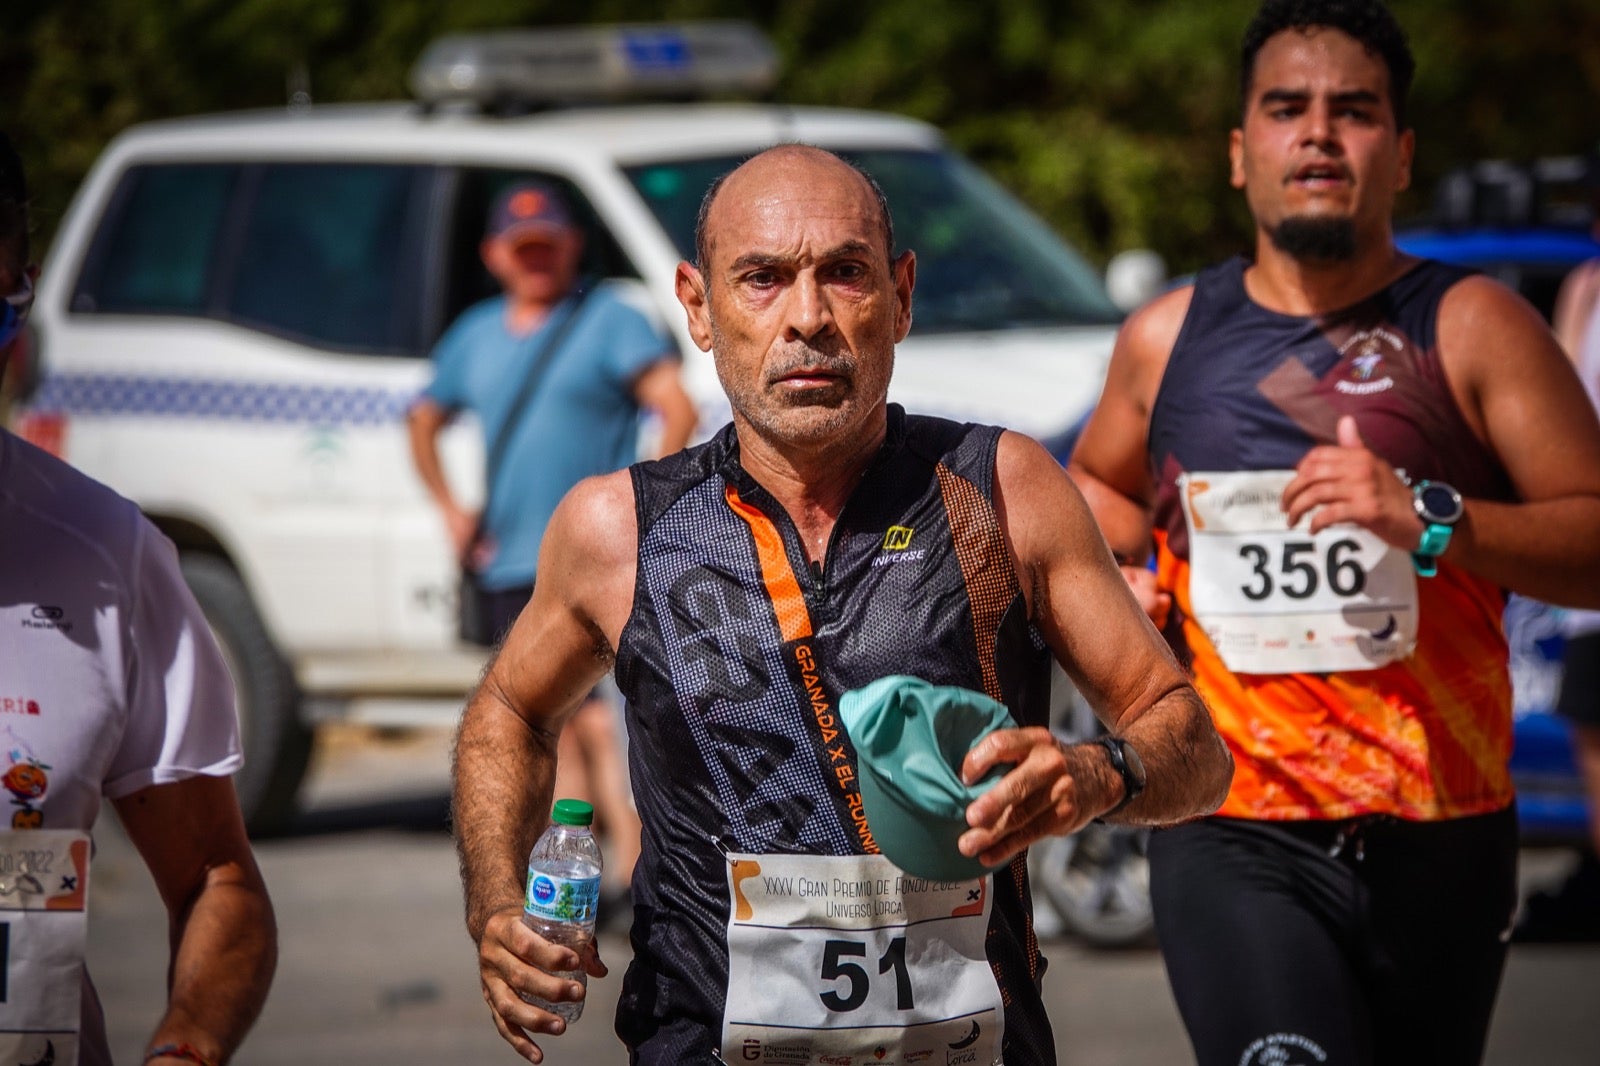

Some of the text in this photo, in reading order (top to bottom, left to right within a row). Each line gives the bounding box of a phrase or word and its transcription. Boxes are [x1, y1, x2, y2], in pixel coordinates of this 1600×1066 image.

[871, 549, 925, 567] INVERSE
[1239, 539, 1368, 601] 356
[795, 645, 839, 744] GRANADA
[828, 745, 847, 762] X
[835, 765, 855, 790] EL
[763, 876, 794, 896] XXXV
[876, 879, 891, 896] DE
[819, 936, 915, 1012] 51
[764, 1045, 810, 1054] Diputación
[946, 1049, 977, 1066] Lorca
